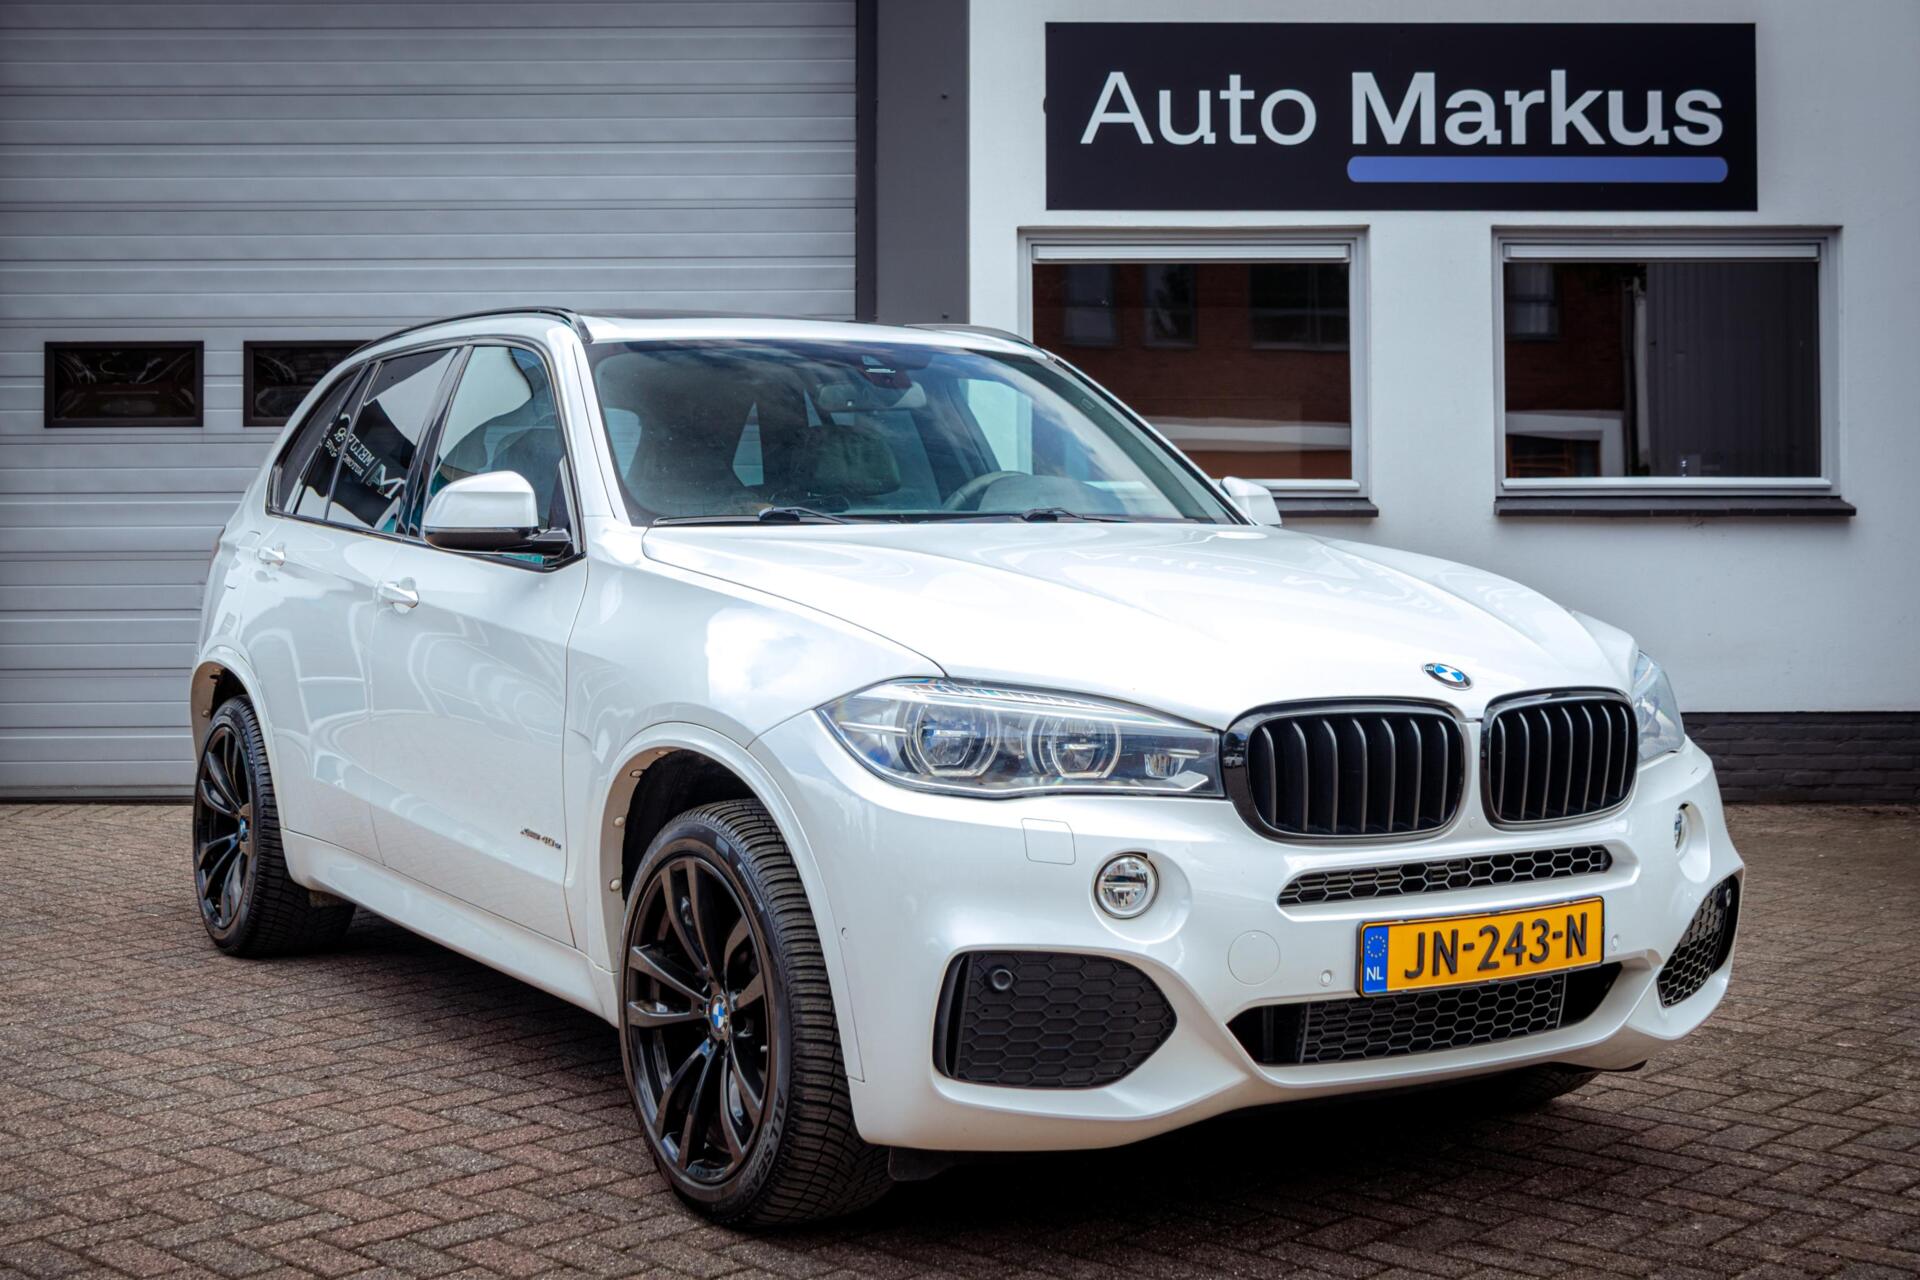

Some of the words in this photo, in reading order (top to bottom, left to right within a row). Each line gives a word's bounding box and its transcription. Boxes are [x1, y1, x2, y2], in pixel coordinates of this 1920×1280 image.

[1080, 71, 1316, 146] Auto
[1351, 69, 1724, 146] Markus
[1366, 966, 1385, 981] NL
[1404, 912, 1588, 980] JN-243-N
